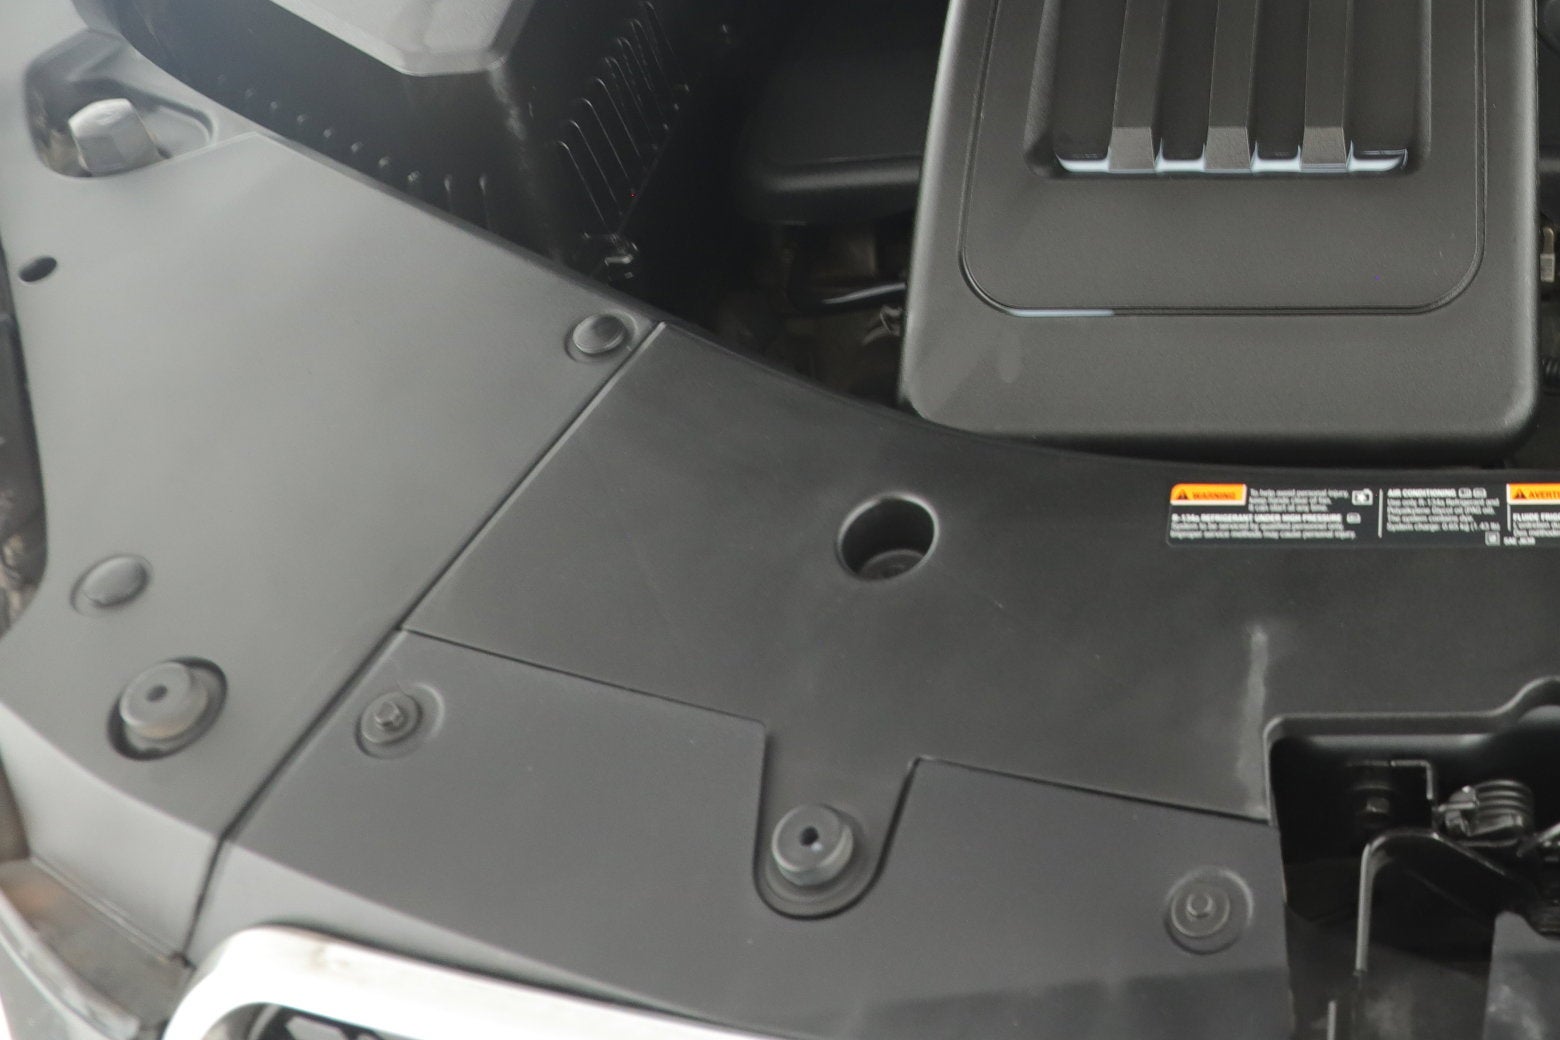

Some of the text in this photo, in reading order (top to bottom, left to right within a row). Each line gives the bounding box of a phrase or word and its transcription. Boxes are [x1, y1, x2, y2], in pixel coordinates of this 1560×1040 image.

[1193, 492, 1236, 500] WARNING
[1387, 488, 1401, 498] AIR
[1402, 488, 1456, 498] CONDITIONING
